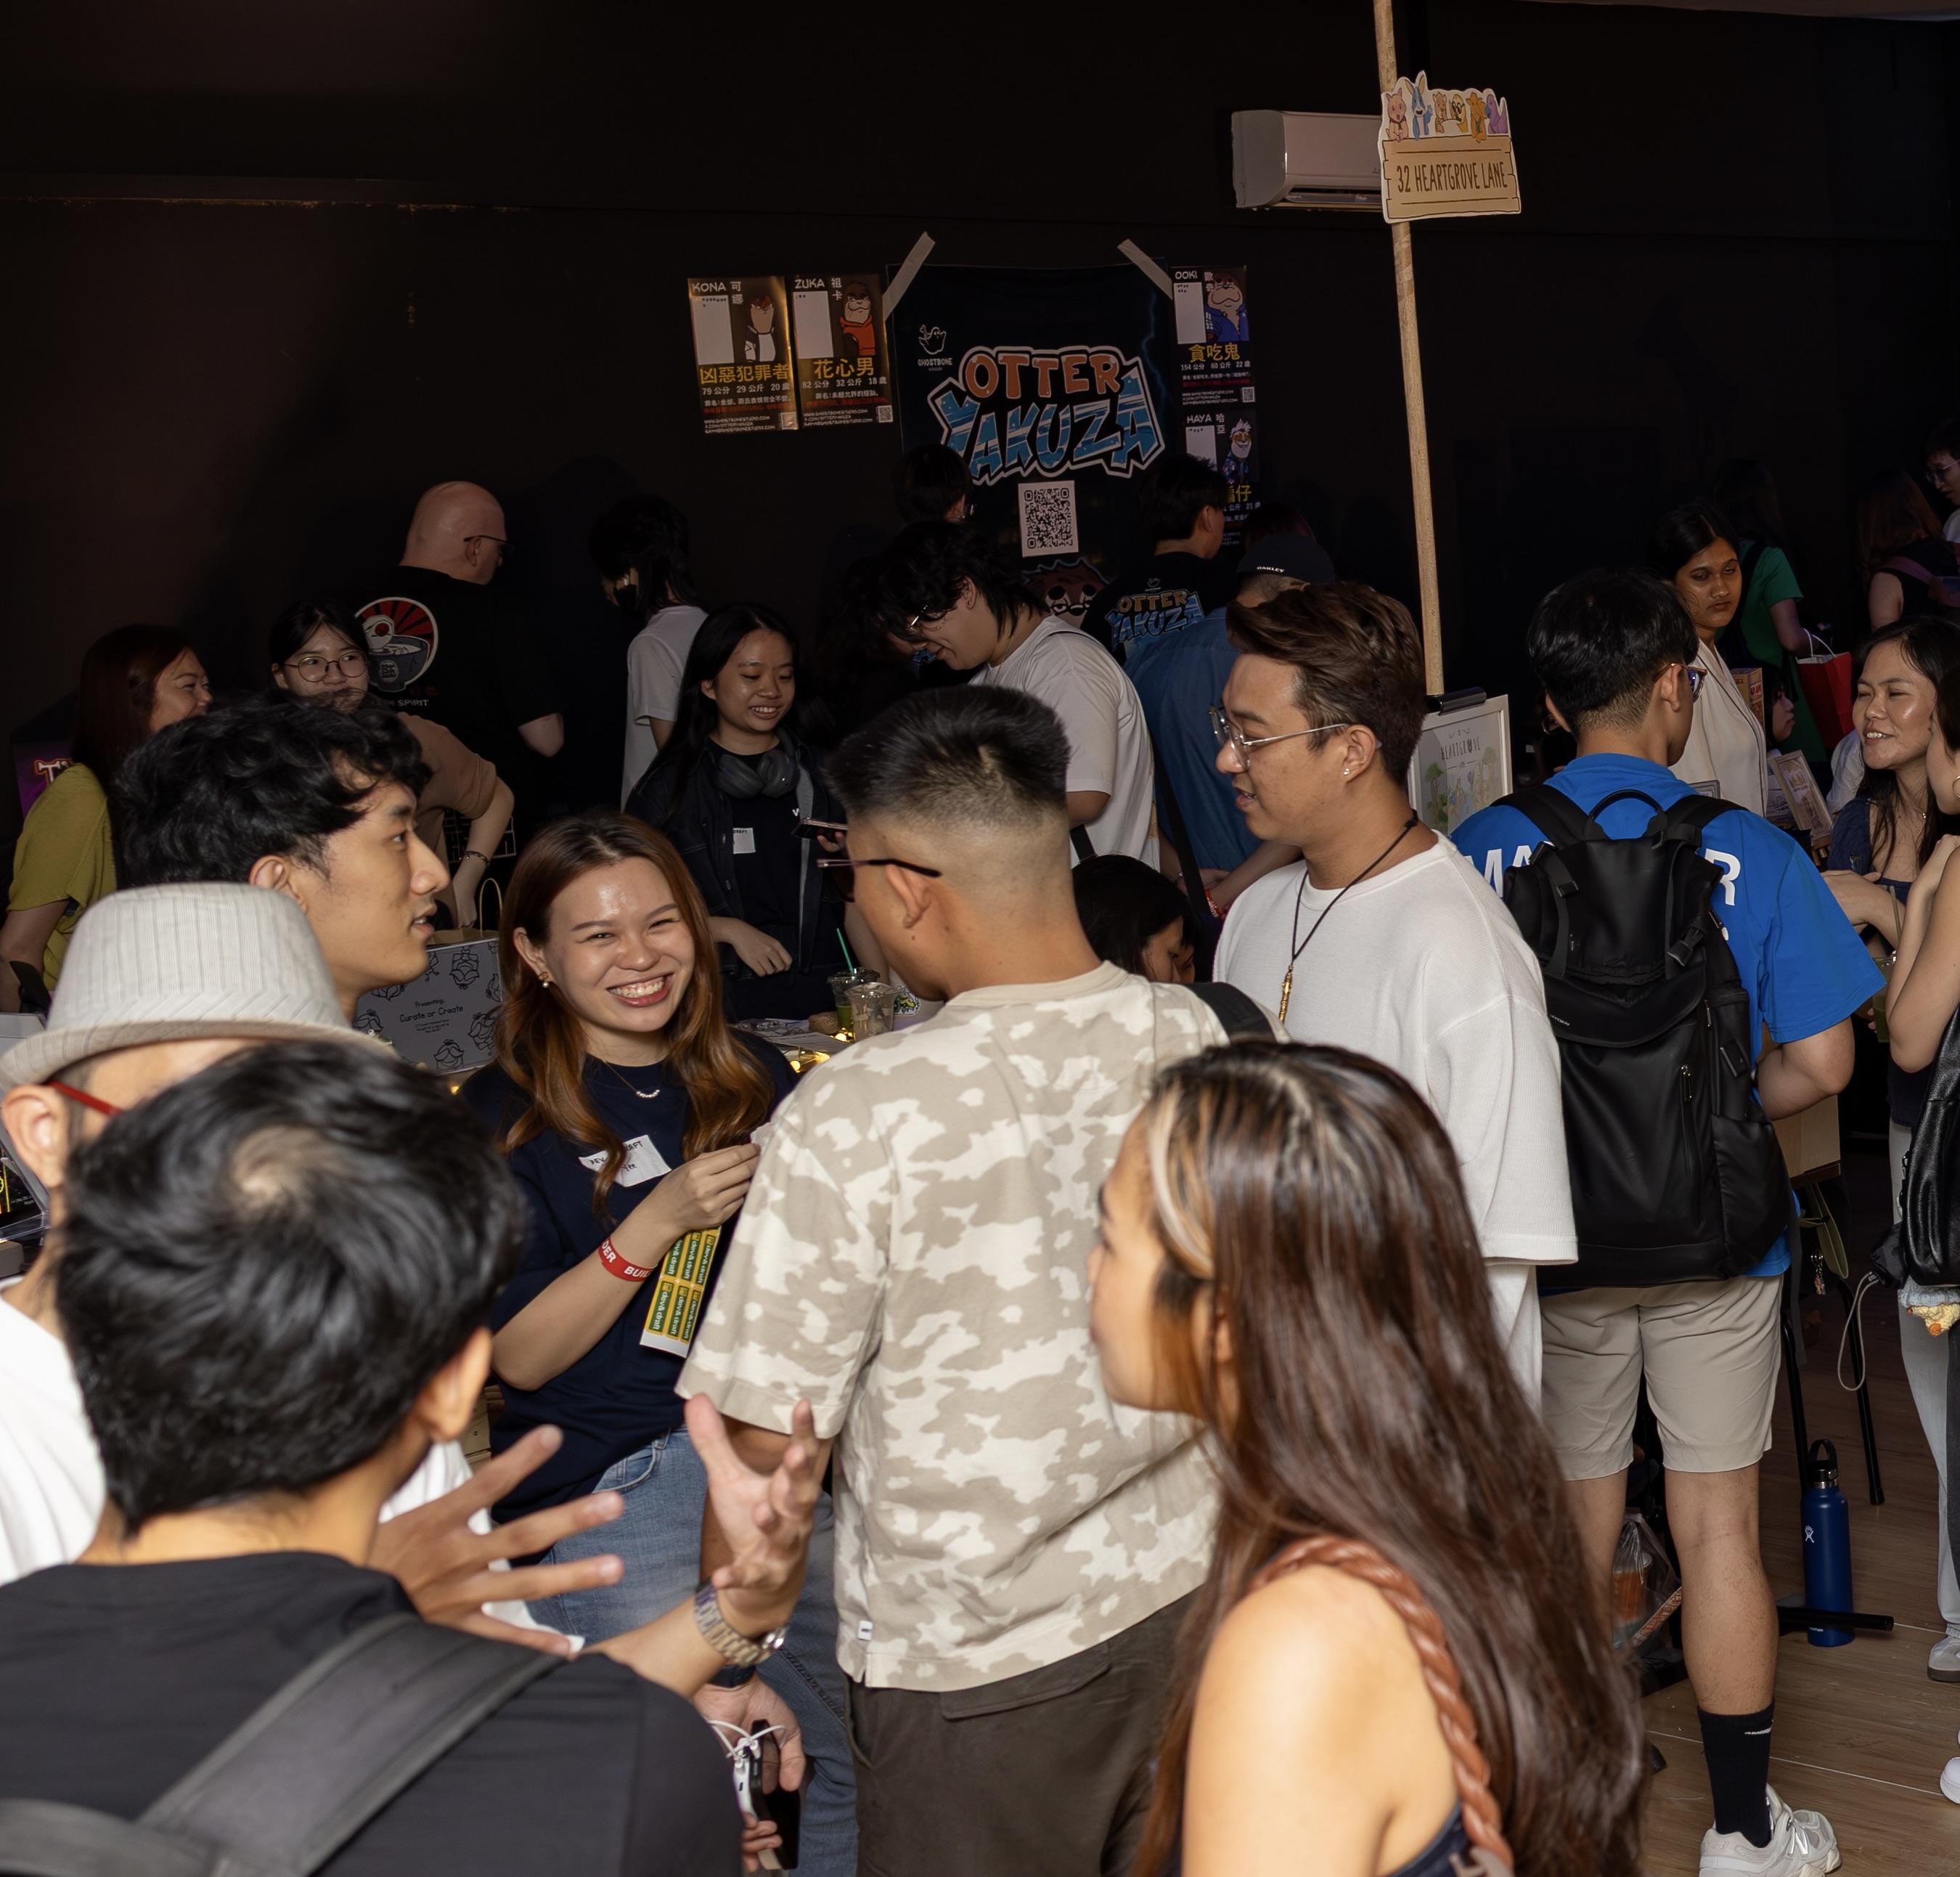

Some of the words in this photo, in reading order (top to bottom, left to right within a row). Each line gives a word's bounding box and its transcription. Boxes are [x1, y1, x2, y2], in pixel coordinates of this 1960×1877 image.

[1397, 165, 1410, 192] 32
[1415, 162, 1479, 192] HEARTGROVE
[1481, 161, 1508, 189] LANE
[794, 278, 825, 289] ZUKA
[1175, 270, 1198, 280] OOKI
[692, 282, 727, 292] KONA
[830, 277, 842, 301] 祖卡
[1188, 343, 1241, 363] 貪吃鬼
[699, 362, 791, 385] 凶惡犯罪者
[812, 357, 874, 379] 花心男
[965, 352, 1122, 399] OTTER
[934, 367, 1159, 479] YAKUZA
[1186, 414, 1212, 423] HAYA
[1118, 589, 1189, 614] OTTER
[1106, 593, 1205, 651] YAKUZA
[400, 1014, 425, 1022] Curate
[438, 1006, 463, 1015] Create
[602, 1240, 616, 1263] DER
[624, 1266, 650, 1278] BUIL
[658, 1291, 668, 1311] dev&
[653, 1311, 664, 1330] draft
[670, 1316, 680, 1335] draft
